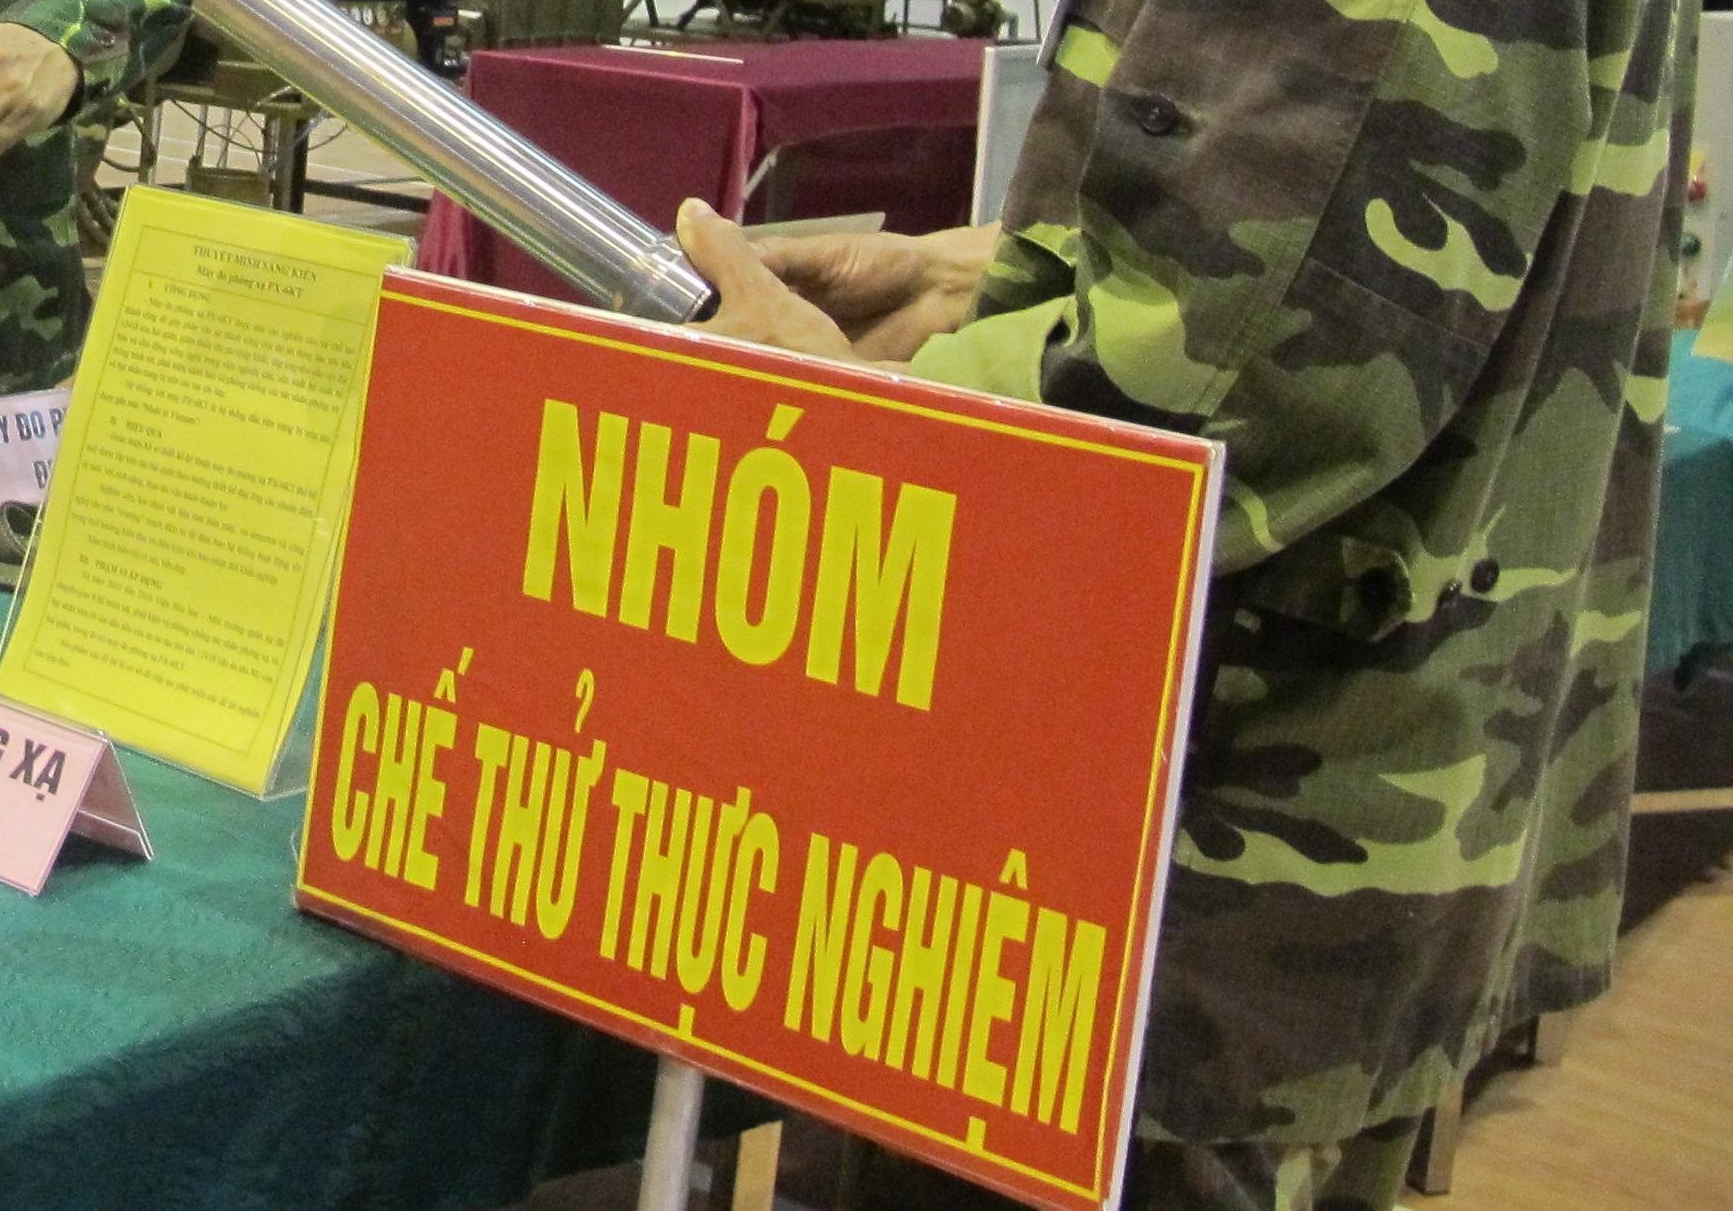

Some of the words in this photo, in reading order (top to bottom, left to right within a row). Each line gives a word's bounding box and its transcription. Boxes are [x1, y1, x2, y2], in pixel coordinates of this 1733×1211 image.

[15, 410, 46, 441] ĐO
[522, 398, 957, 712] NHÓM
[9, 738, 69, 803] XẠ
[330, 646, 475, 890] CHẾ
[463, 669, 608, 940] THỬ
[598, 768, 780, 1038] THỰC
[784, 832, 1108, 1151] NGHIỆM
